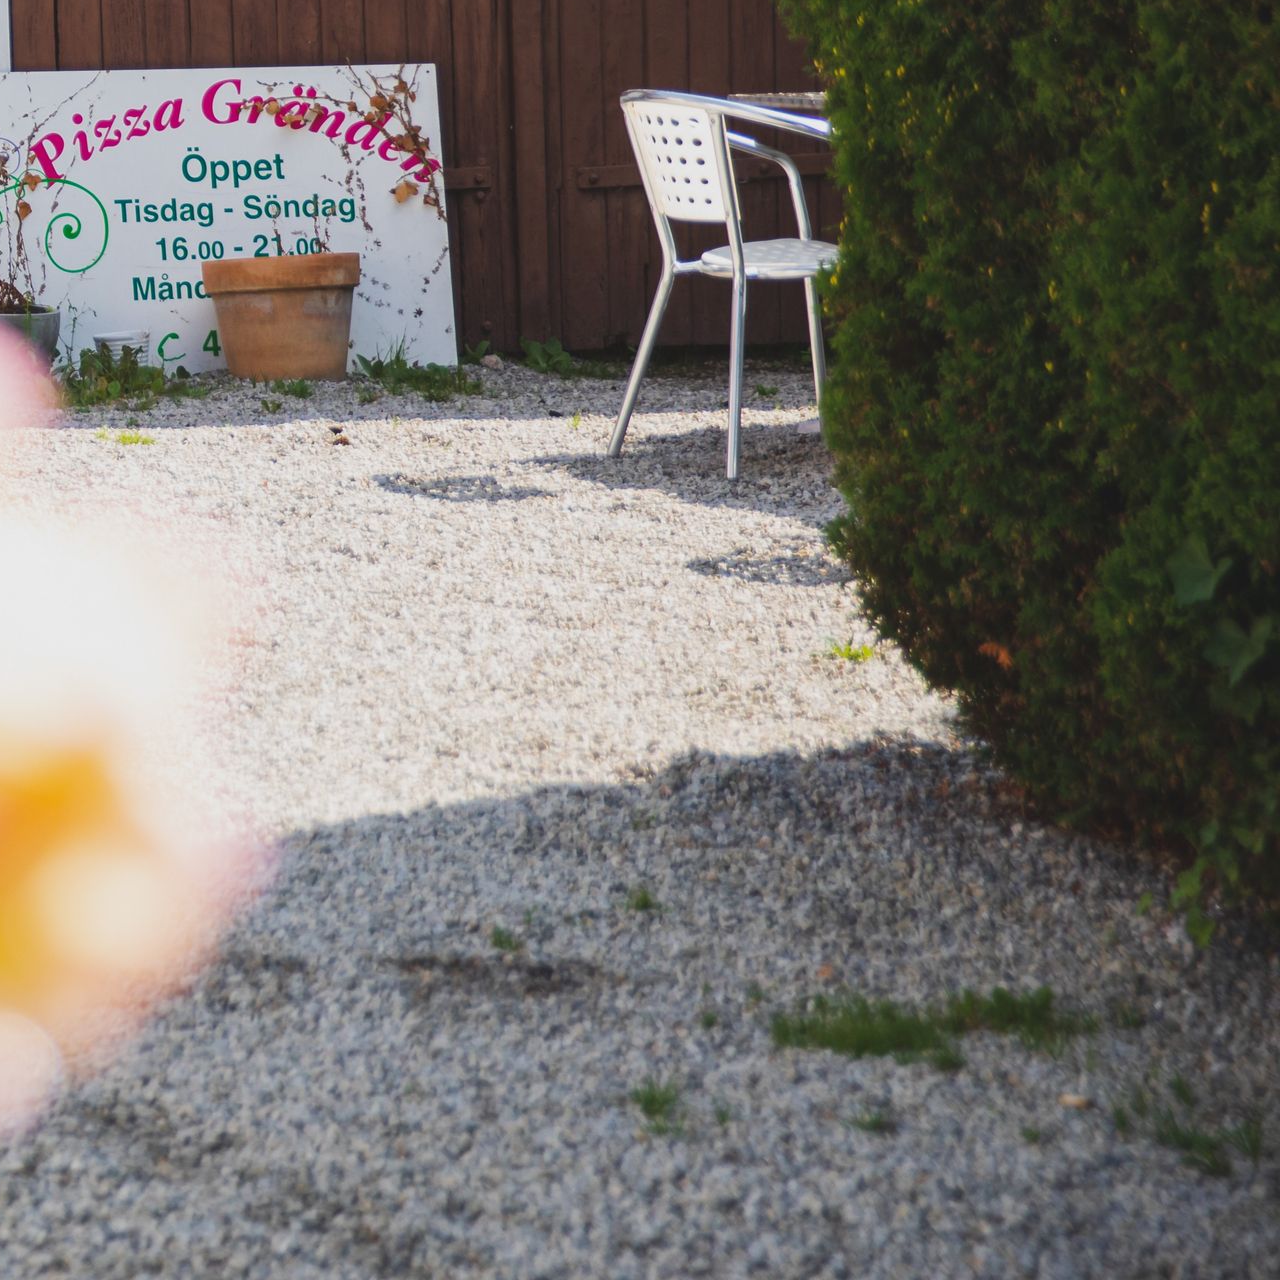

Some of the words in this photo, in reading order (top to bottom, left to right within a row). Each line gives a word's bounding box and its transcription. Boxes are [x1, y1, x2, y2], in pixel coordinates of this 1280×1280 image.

[29, 98, 186, 190] Pizza
[200, 78, 441, 183] Gränden
[180, 146, 286, 189] Öppet
[113, 197, 214, 227] Tisdag
[242, 193, 357, 222] Söndag
[155, 236, 225, 261] 16.00
[202, 329, 221, 357] 4
